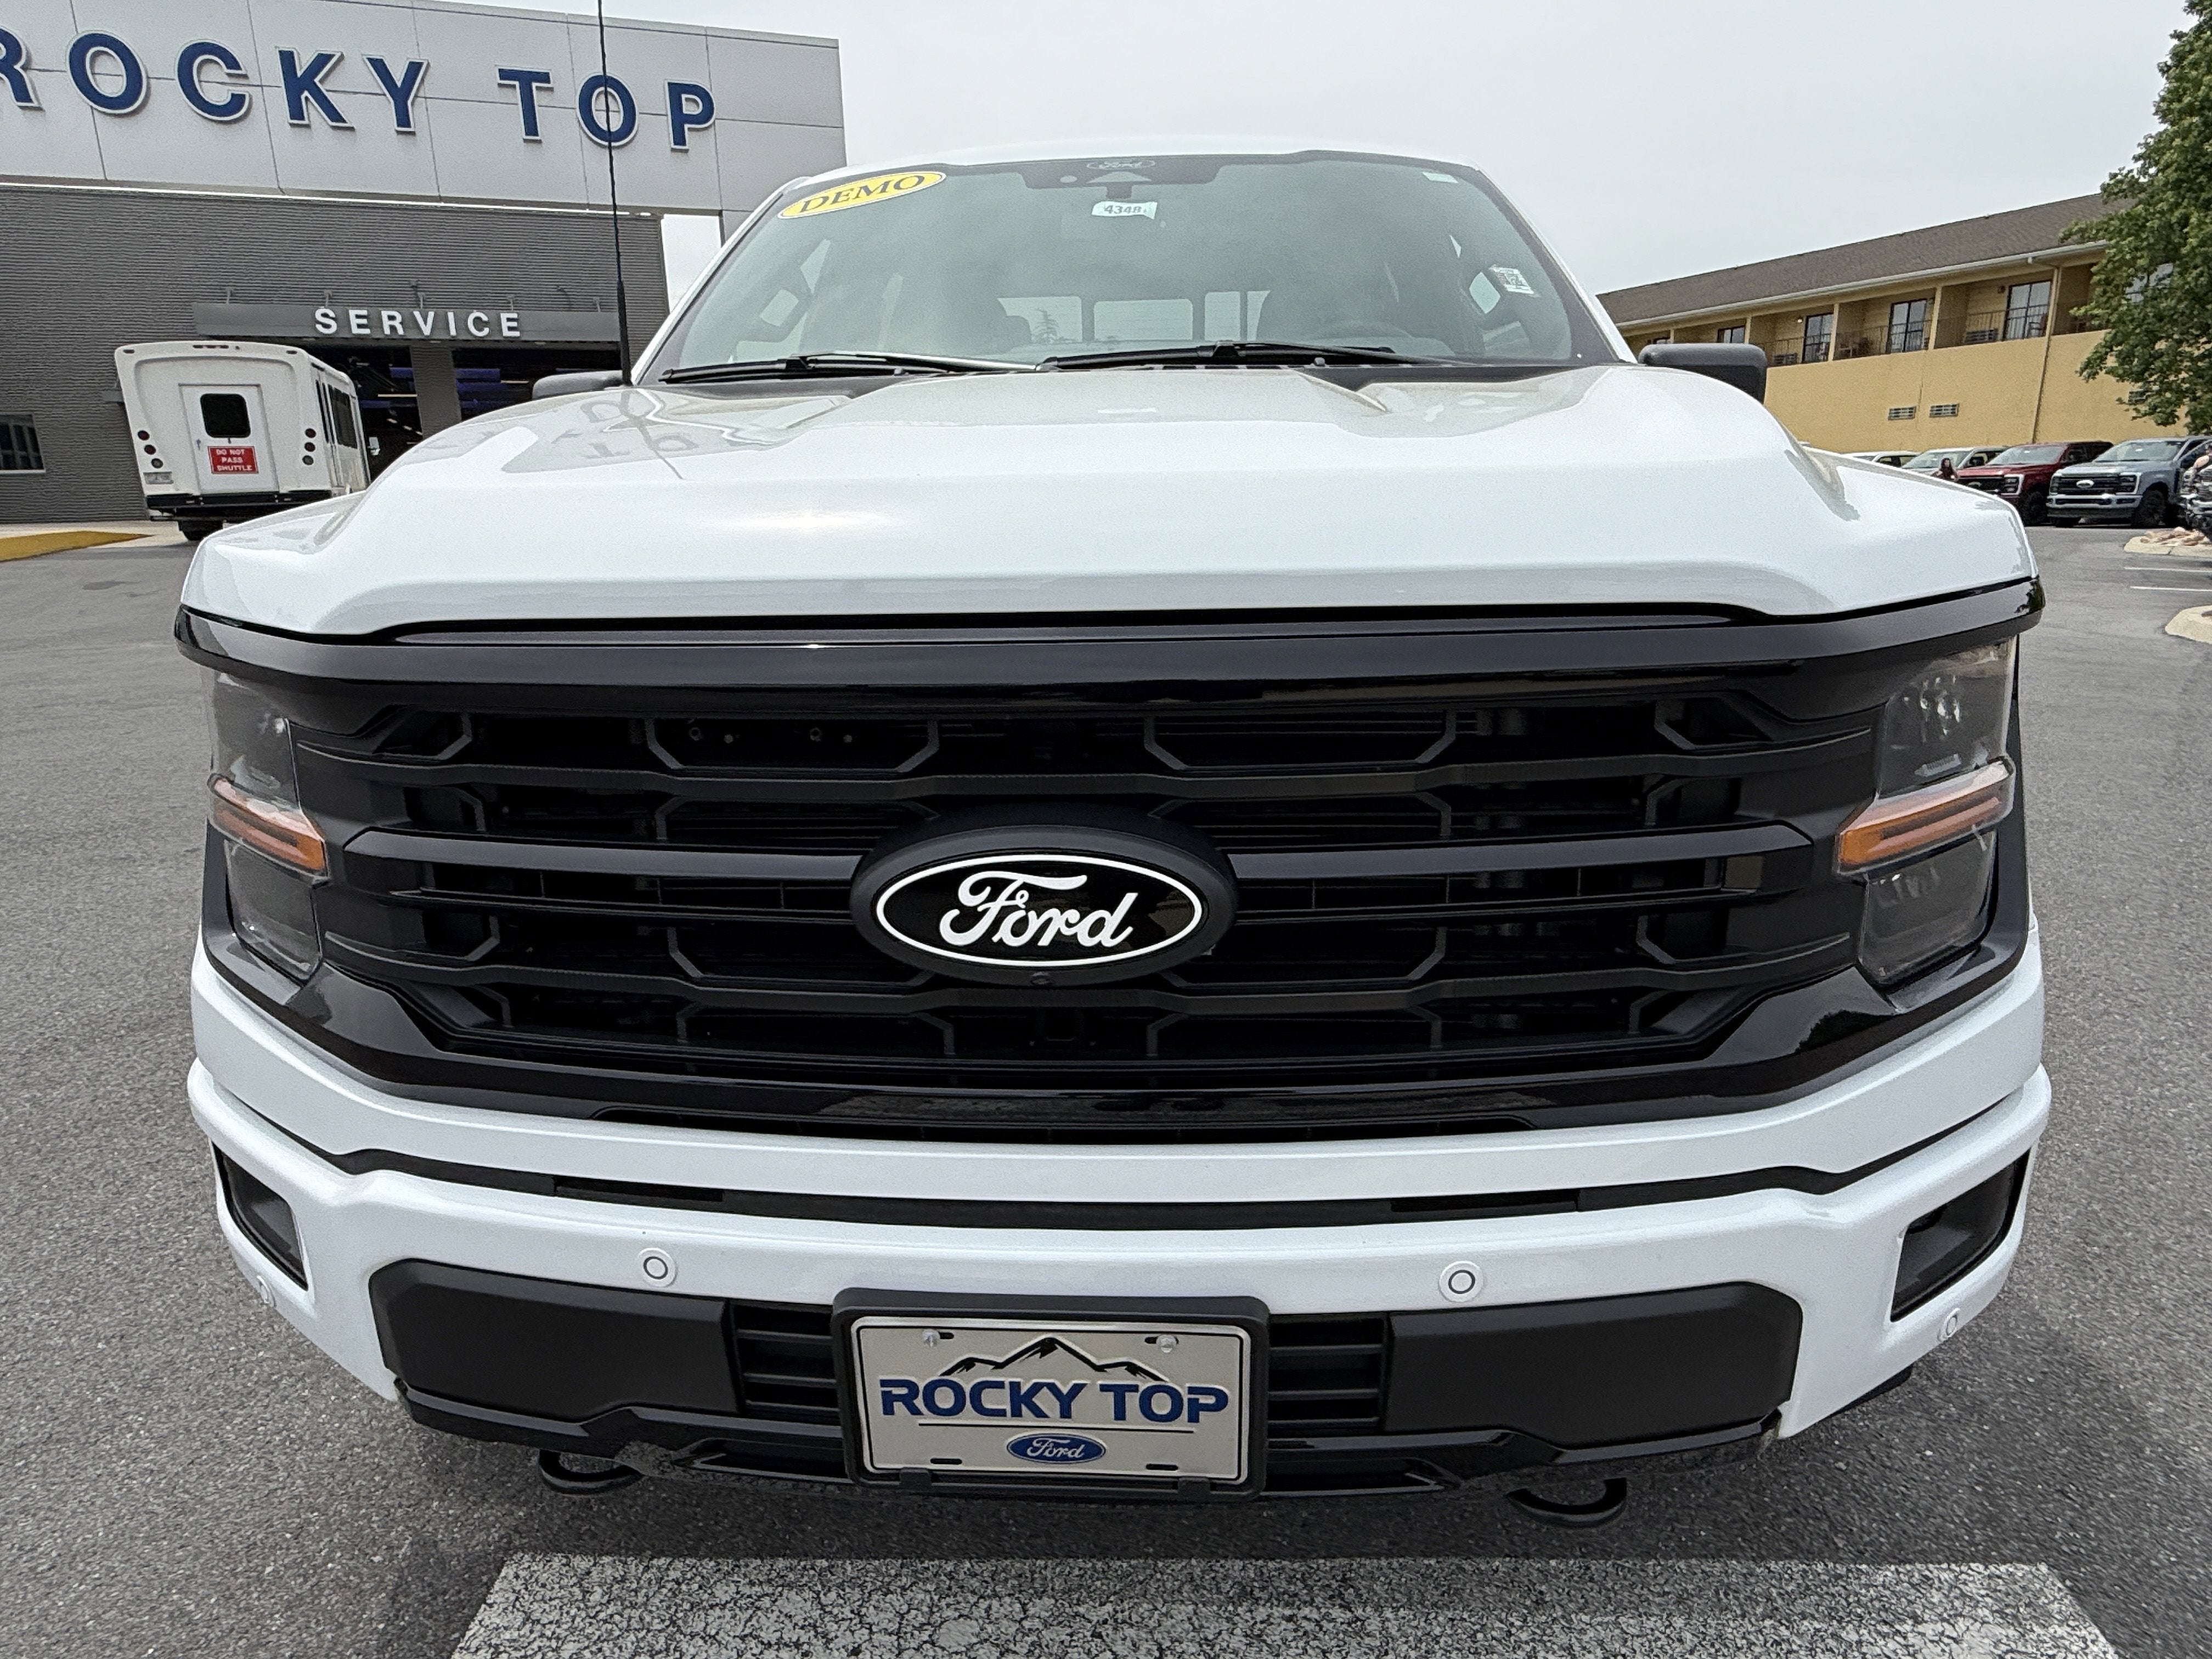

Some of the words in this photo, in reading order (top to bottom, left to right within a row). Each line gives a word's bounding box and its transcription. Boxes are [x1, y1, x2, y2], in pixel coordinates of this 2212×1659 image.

[495, 65, 715, 151] TOP
[800, 176, 925, 212] DEMO
[314, 307, 521, 337] SERVICE
[939, 870, 1138, 947] Ford
[880, 1379, 1086, 1418] ROCKY
[1099, 1384, 1229, 1423] TOP
[1026, 1437, 1085, 1458] Ford
